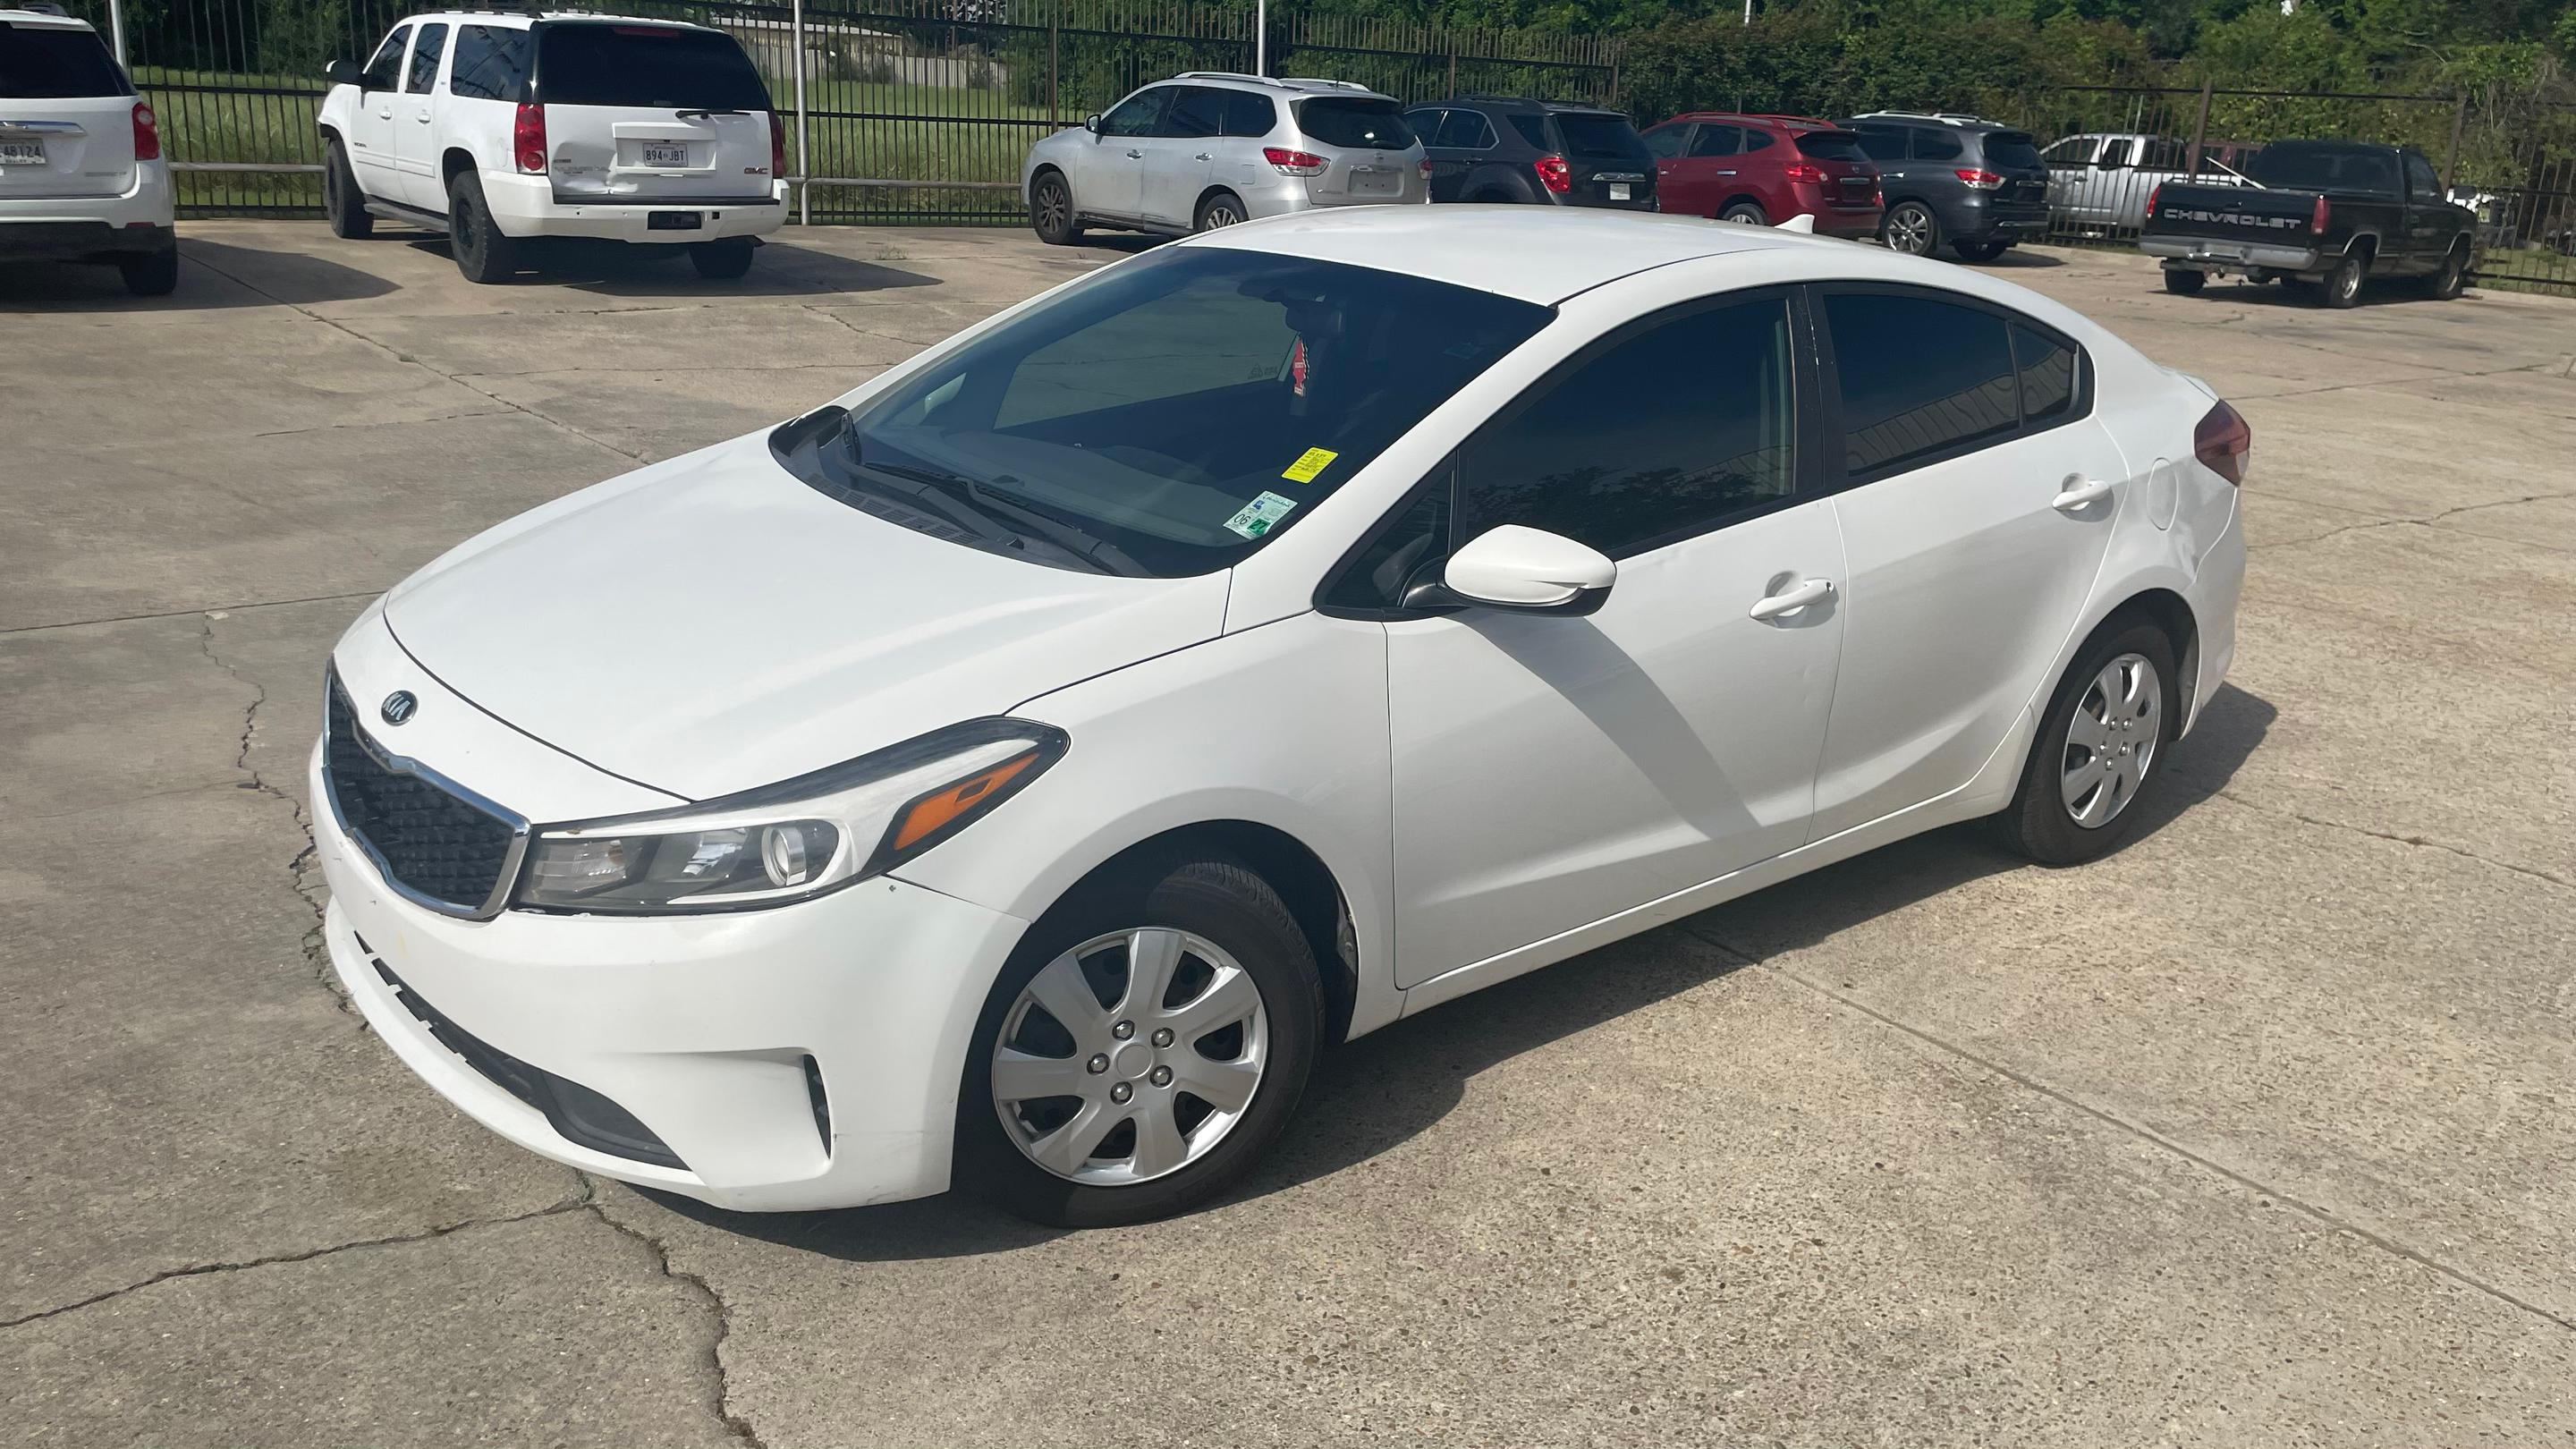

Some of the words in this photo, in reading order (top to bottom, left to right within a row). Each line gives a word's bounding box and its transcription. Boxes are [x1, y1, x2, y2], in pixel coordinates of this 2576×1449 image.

[646, 149, 663, 161] 894
[669, 149, 684, 162] JBT
[743, 166, 769, 175] GMC
[2164, 208, 2302, 230] CHEVROLET
[1233, 513, 1251, 525] 06
[1250, 520, 1268, 530] 27
[382, 691, 411, 721] KIA
